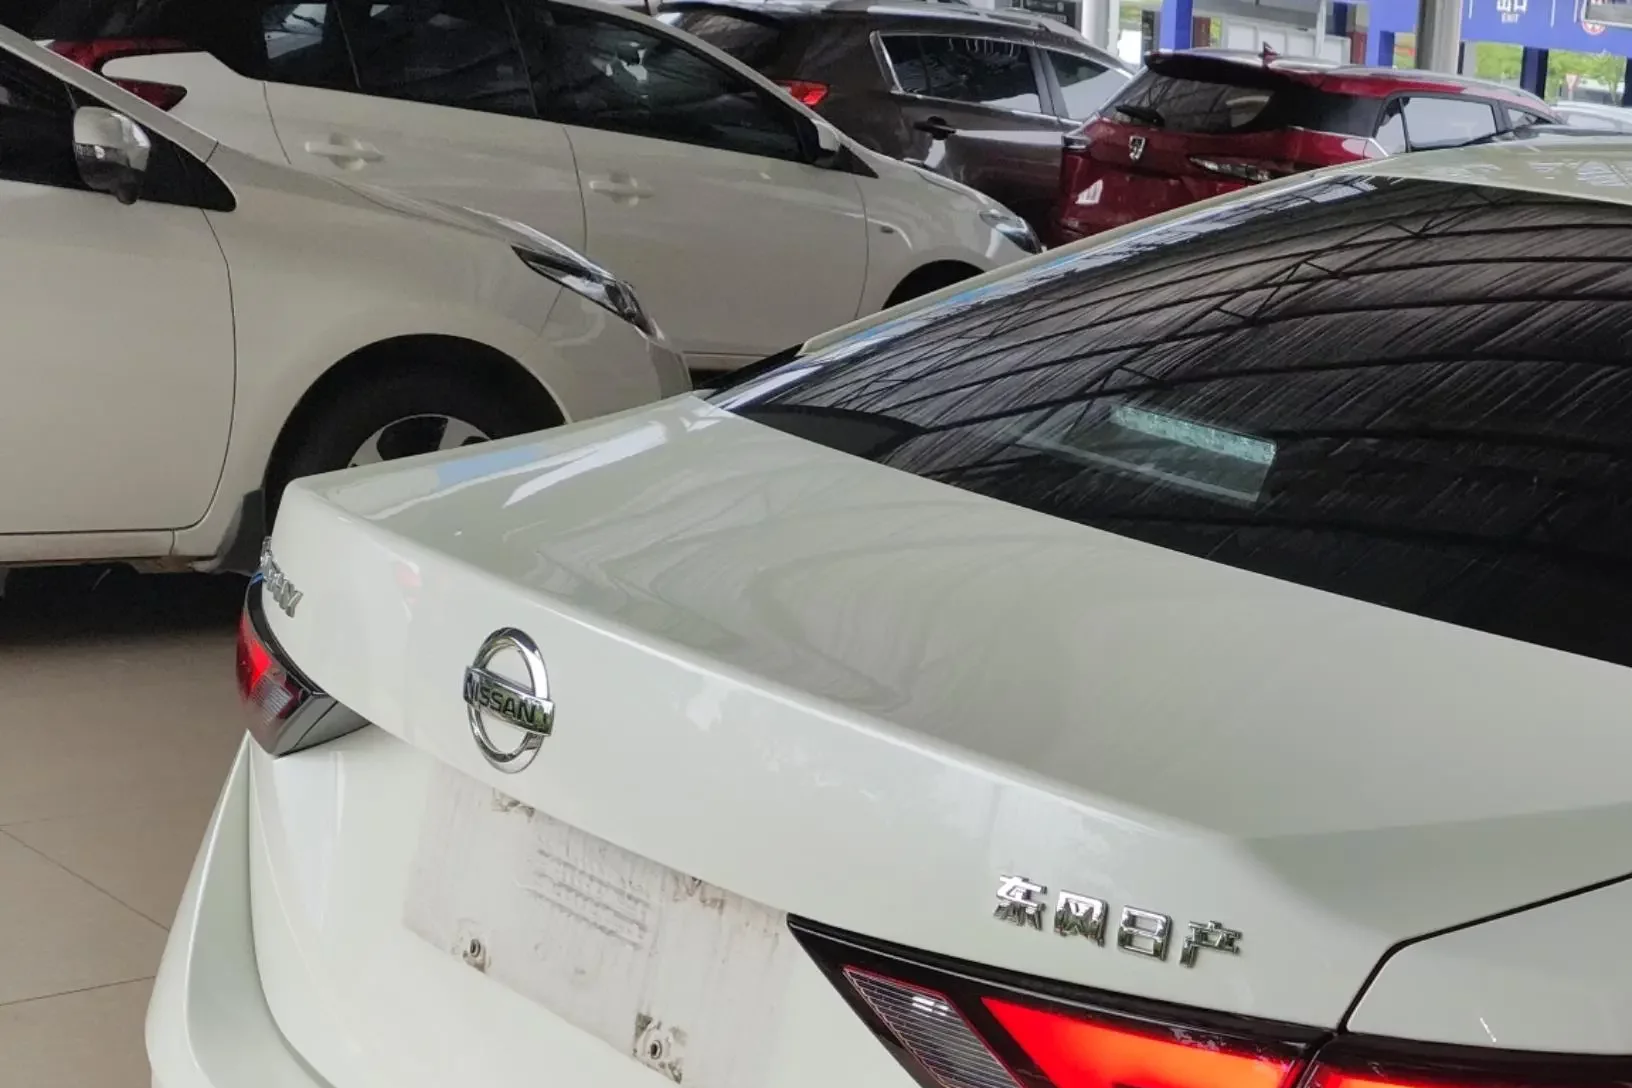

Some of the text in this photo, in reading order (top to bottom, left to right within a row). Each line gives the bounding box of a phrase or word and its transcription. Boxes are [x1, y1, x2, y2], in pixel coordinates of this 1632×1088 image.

[464, 673, 537, 725] NISSAN
[993, 874, 1243, 968] 东风日产
